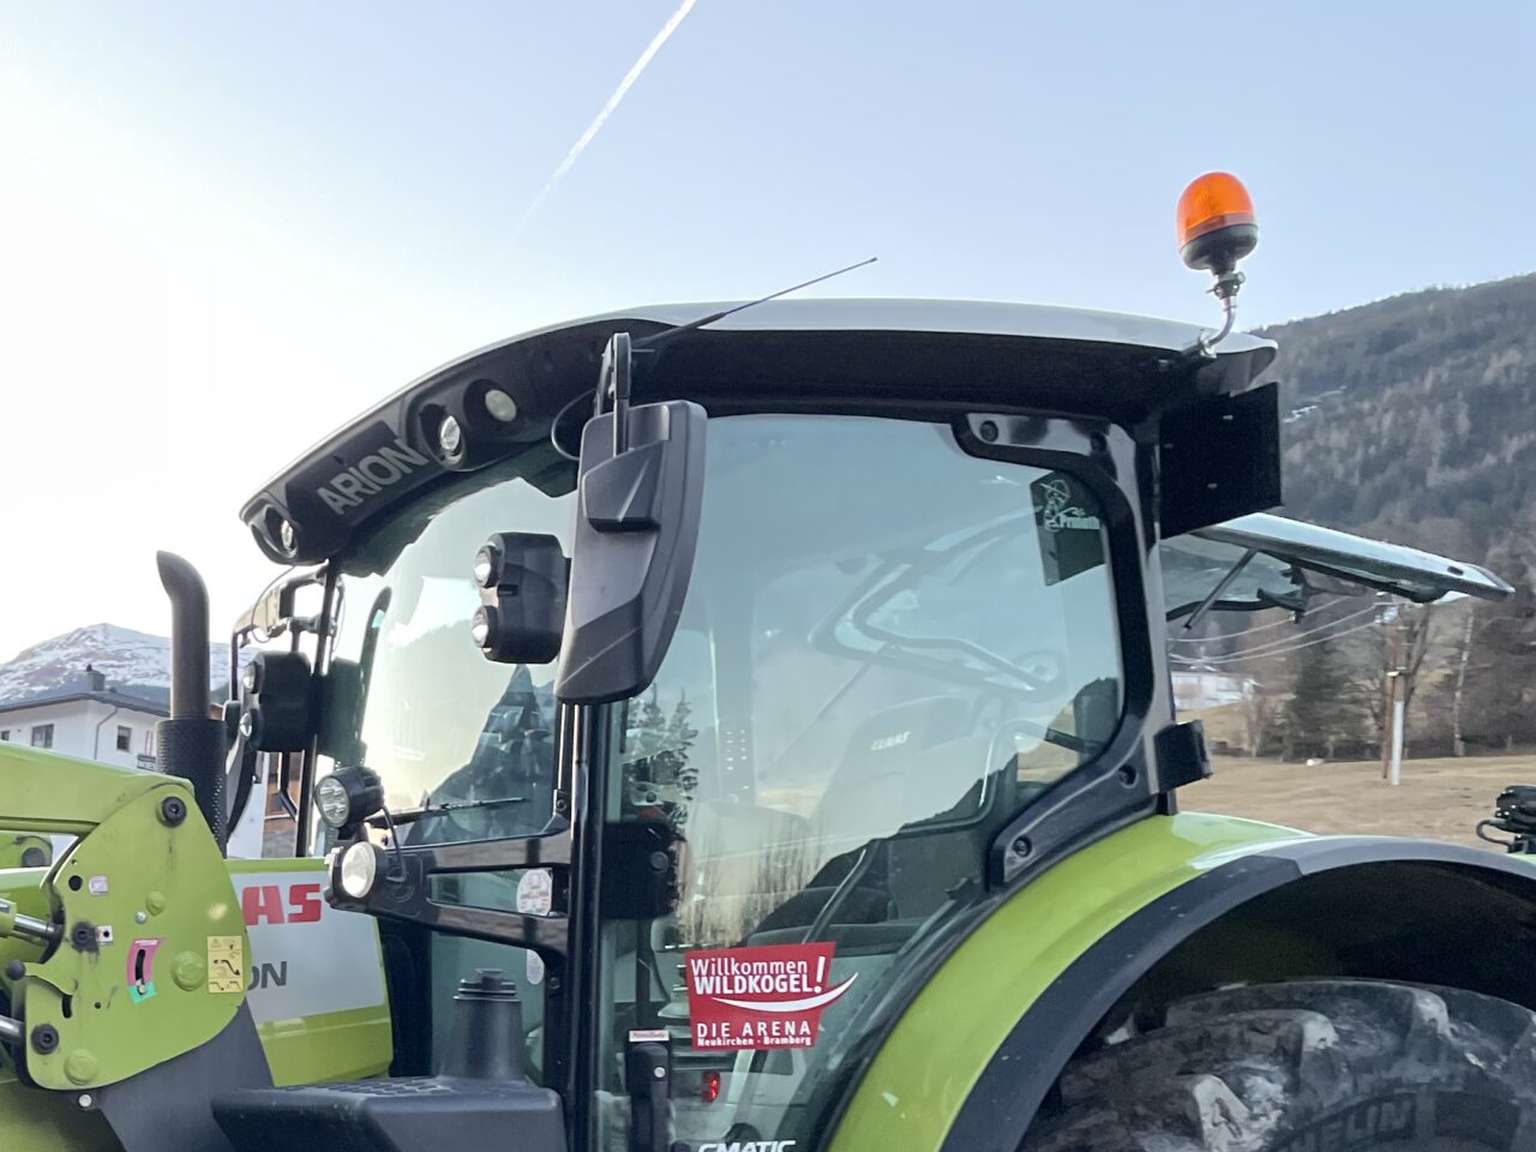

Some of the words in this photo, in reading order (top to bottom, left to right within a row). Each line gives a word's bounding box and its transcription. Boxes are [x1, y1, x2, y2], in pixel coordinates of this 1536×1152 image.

[317, 439, 429, 515] ARION
[690, 957, 807, 976] Willkommen
[694, 955, 826, 995] WILDKOGEL!
[696, 1022, 730, 1038] DIE
[742, 1020, 812, 1037] ARENA
[697, 1036, 754, 1047] Neukirchen
[763, 1035, 812, 1046] Bramberg
